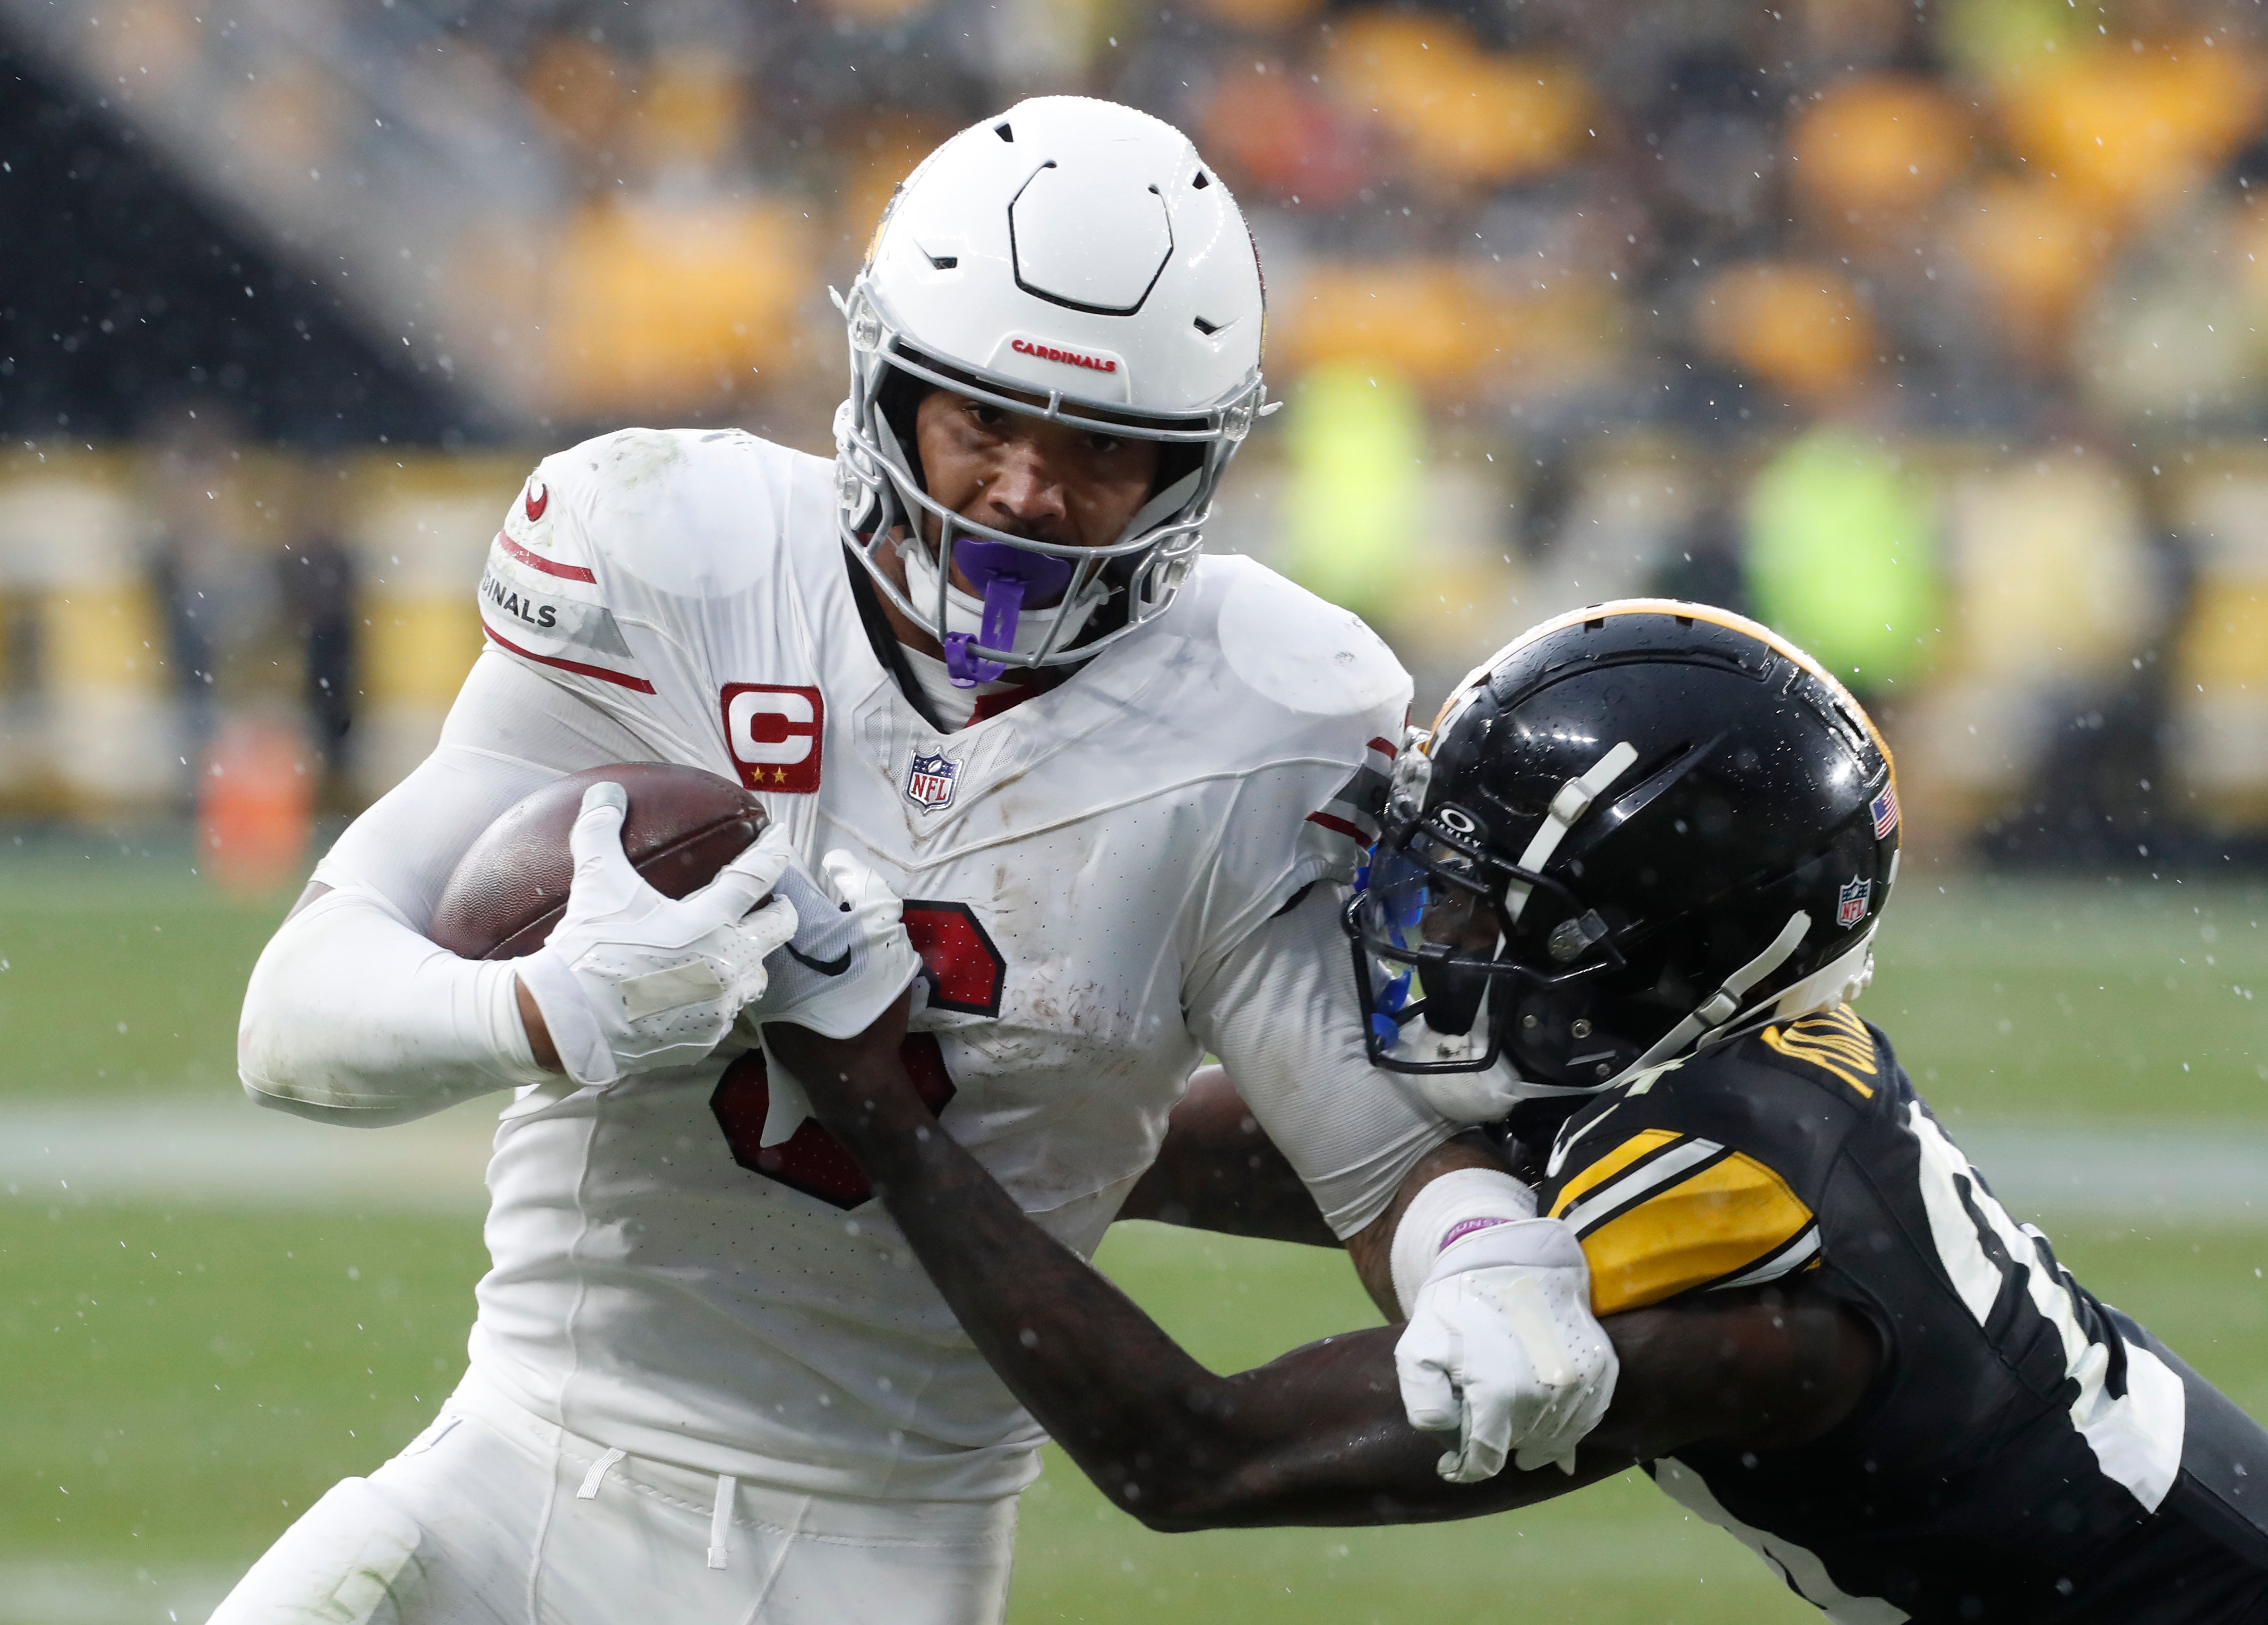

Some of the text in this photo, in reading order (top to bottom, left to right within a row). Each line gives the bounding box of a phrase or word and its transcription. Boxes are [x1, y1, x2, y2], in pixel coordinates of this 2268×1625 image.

[1012, 339, 1117, 372] CARDINALS
[728, 691, 814, 765] C
[911, 774, 947, 802] NFL
[1841, 899, 1863, 921] NFL
